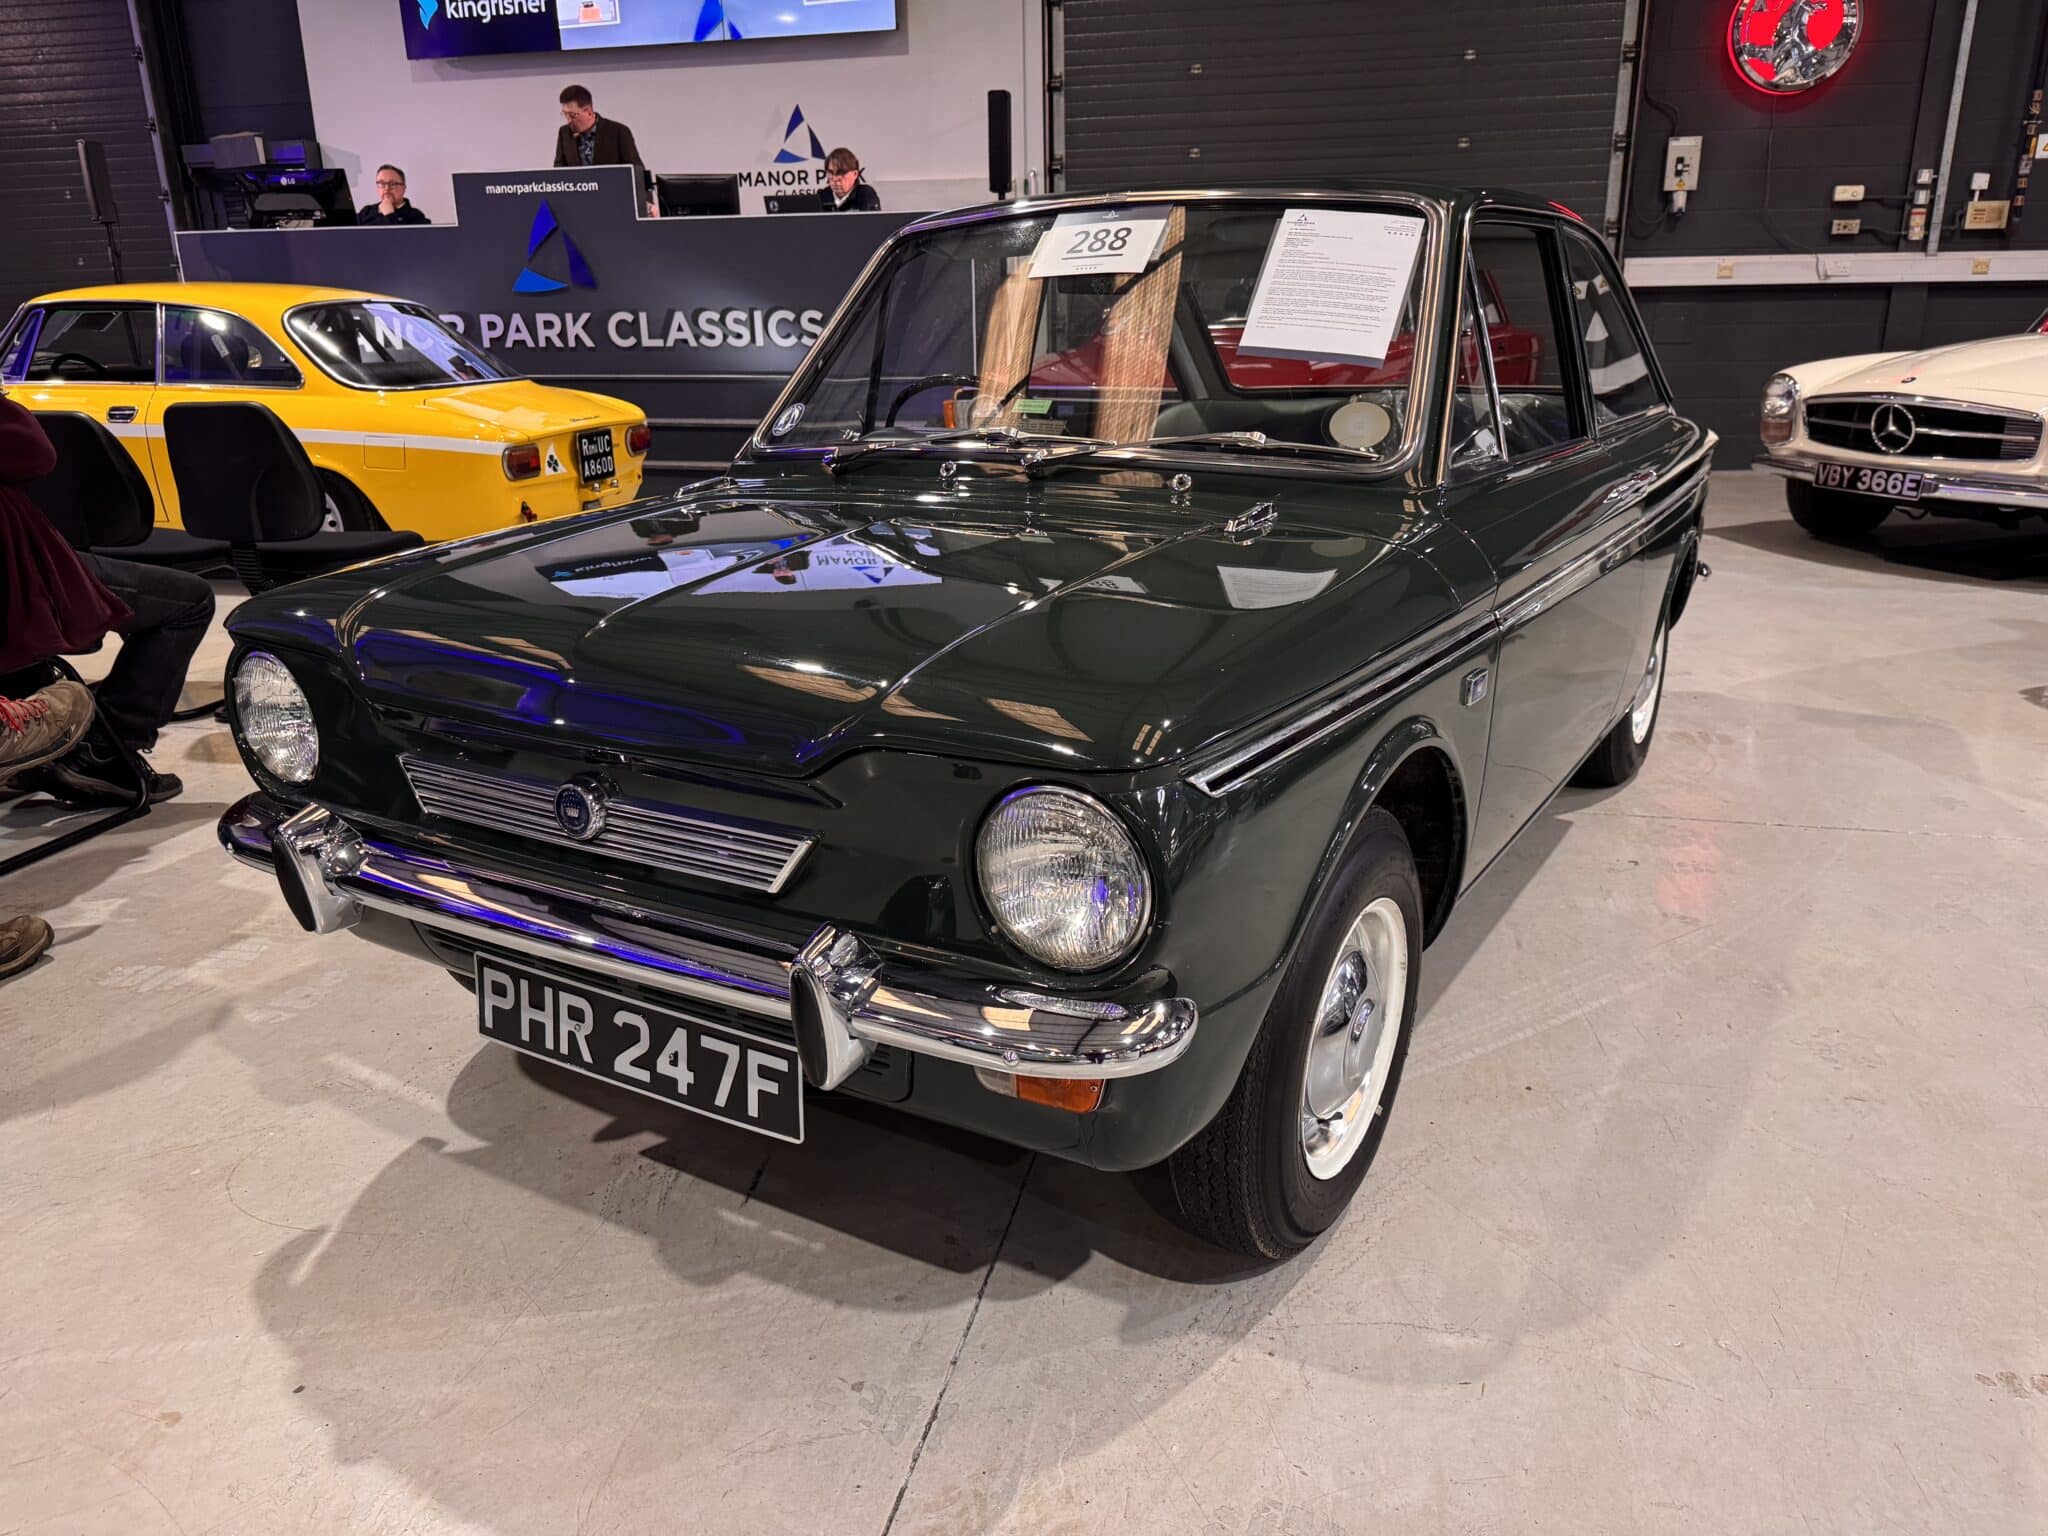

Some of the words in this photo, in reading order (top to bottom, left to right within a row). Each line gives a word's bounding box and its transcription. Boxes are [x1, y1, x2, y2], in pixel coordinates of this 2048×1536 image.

[485, 181, 599, 195] manorparkclassics.com
[739, 170, 809, 187] MANOR
[1066, 227, 1132, 255] 288
[480, 311, 596, 350] PARK
[608, 309, 825, 349] CLASSICS
[1818, 463, 1855, 488] VBY
[1856, 469, 1922, 497] 366E
[483, 967, 594, 1065] PHR
[612, 1010, 789, 1118] 247F
